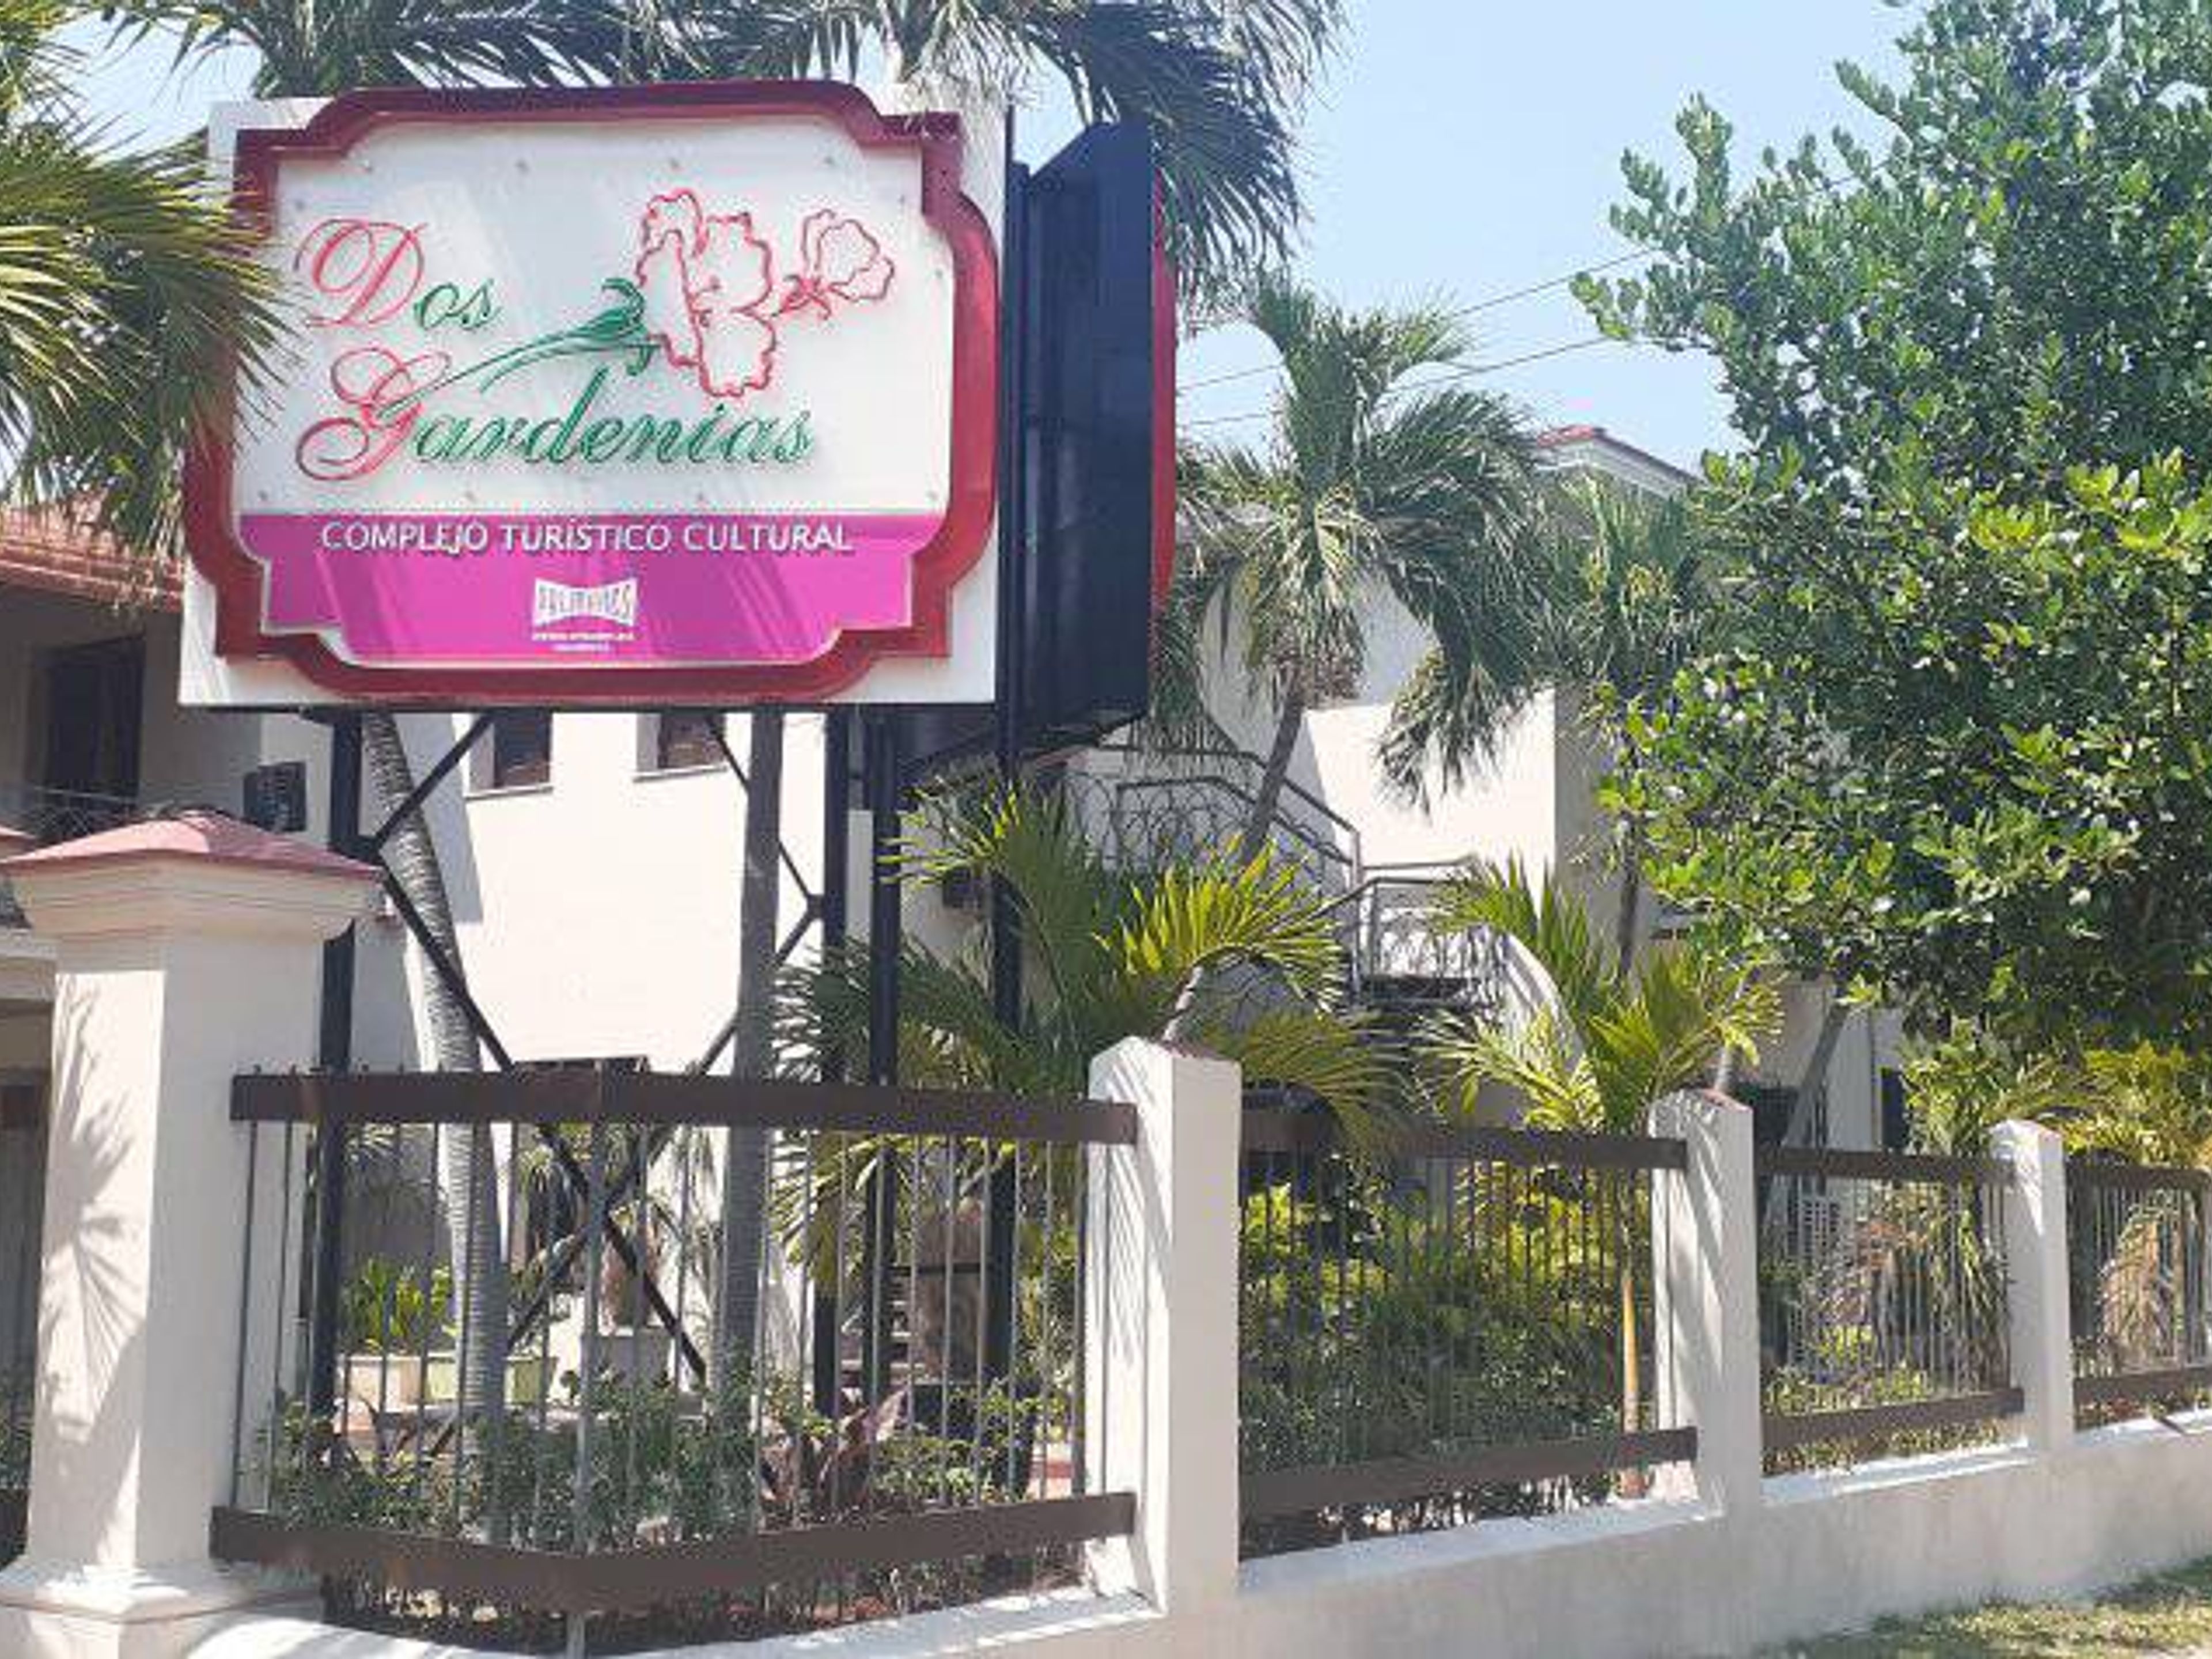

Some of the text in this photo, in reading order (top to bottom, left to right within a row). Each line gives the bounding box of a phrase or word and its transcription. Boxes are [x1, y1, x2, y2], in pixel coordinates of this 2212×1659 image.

[294, 218, 501, 331] Dos
[297, 347, 816, 481] Gardenias
[321, 519, 854, 554] COMPLEJO TURÍSTICO CULTURAL
